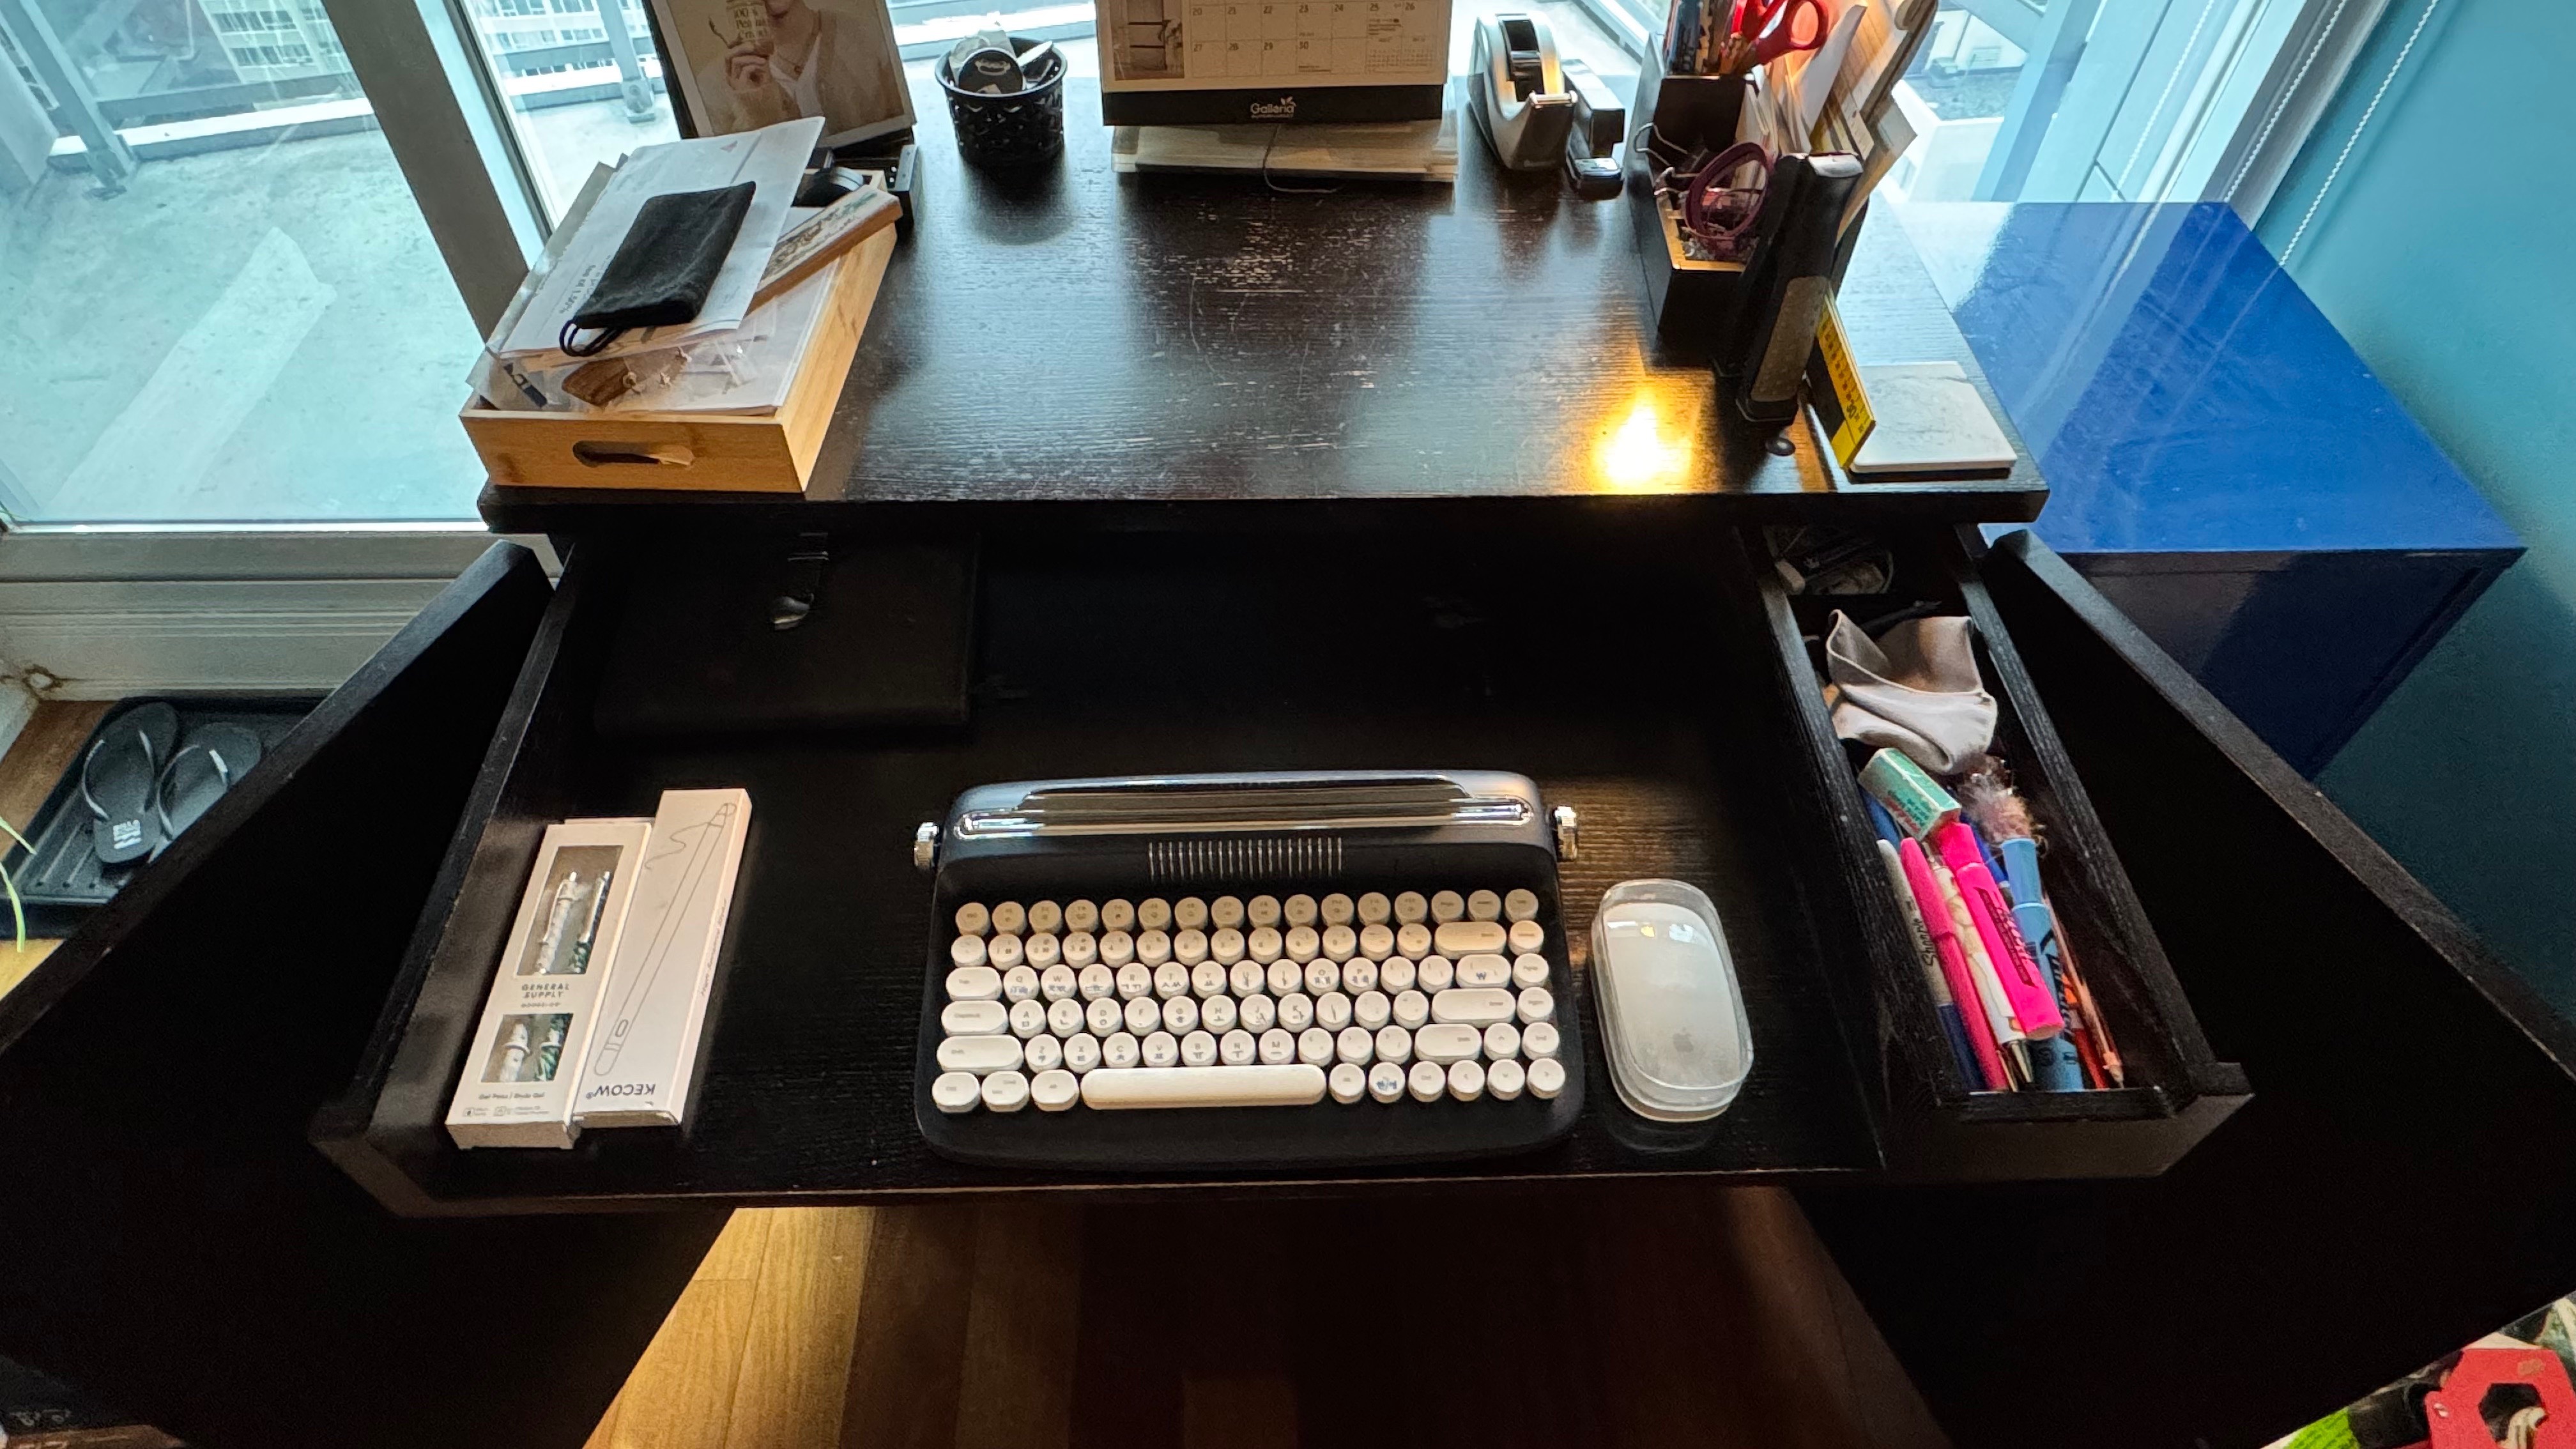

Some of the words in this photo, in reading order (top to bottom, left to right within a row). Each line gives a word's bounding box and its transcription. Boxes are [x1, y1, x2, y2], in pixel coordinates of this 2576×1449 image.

[1228, 6, 1236, 15] 21
[1263, 6, 1273, 14] 22
[1299, 4, 1308, 13] 23
[1334, 4, 1344, 12] 24
[1369, 3, 1379, 12] 25
[1404, 2, 1416, 11] 26
[1192, 7, 1202, 16] 20
[1193, 43, 1202, 52] 27
[1229, 43, 1239, 51] 28
[1264, 42, 1273, 50] 29
[1299, 41, 1309, 50] 30
[1250, 103, 1294, 114] Galleria
